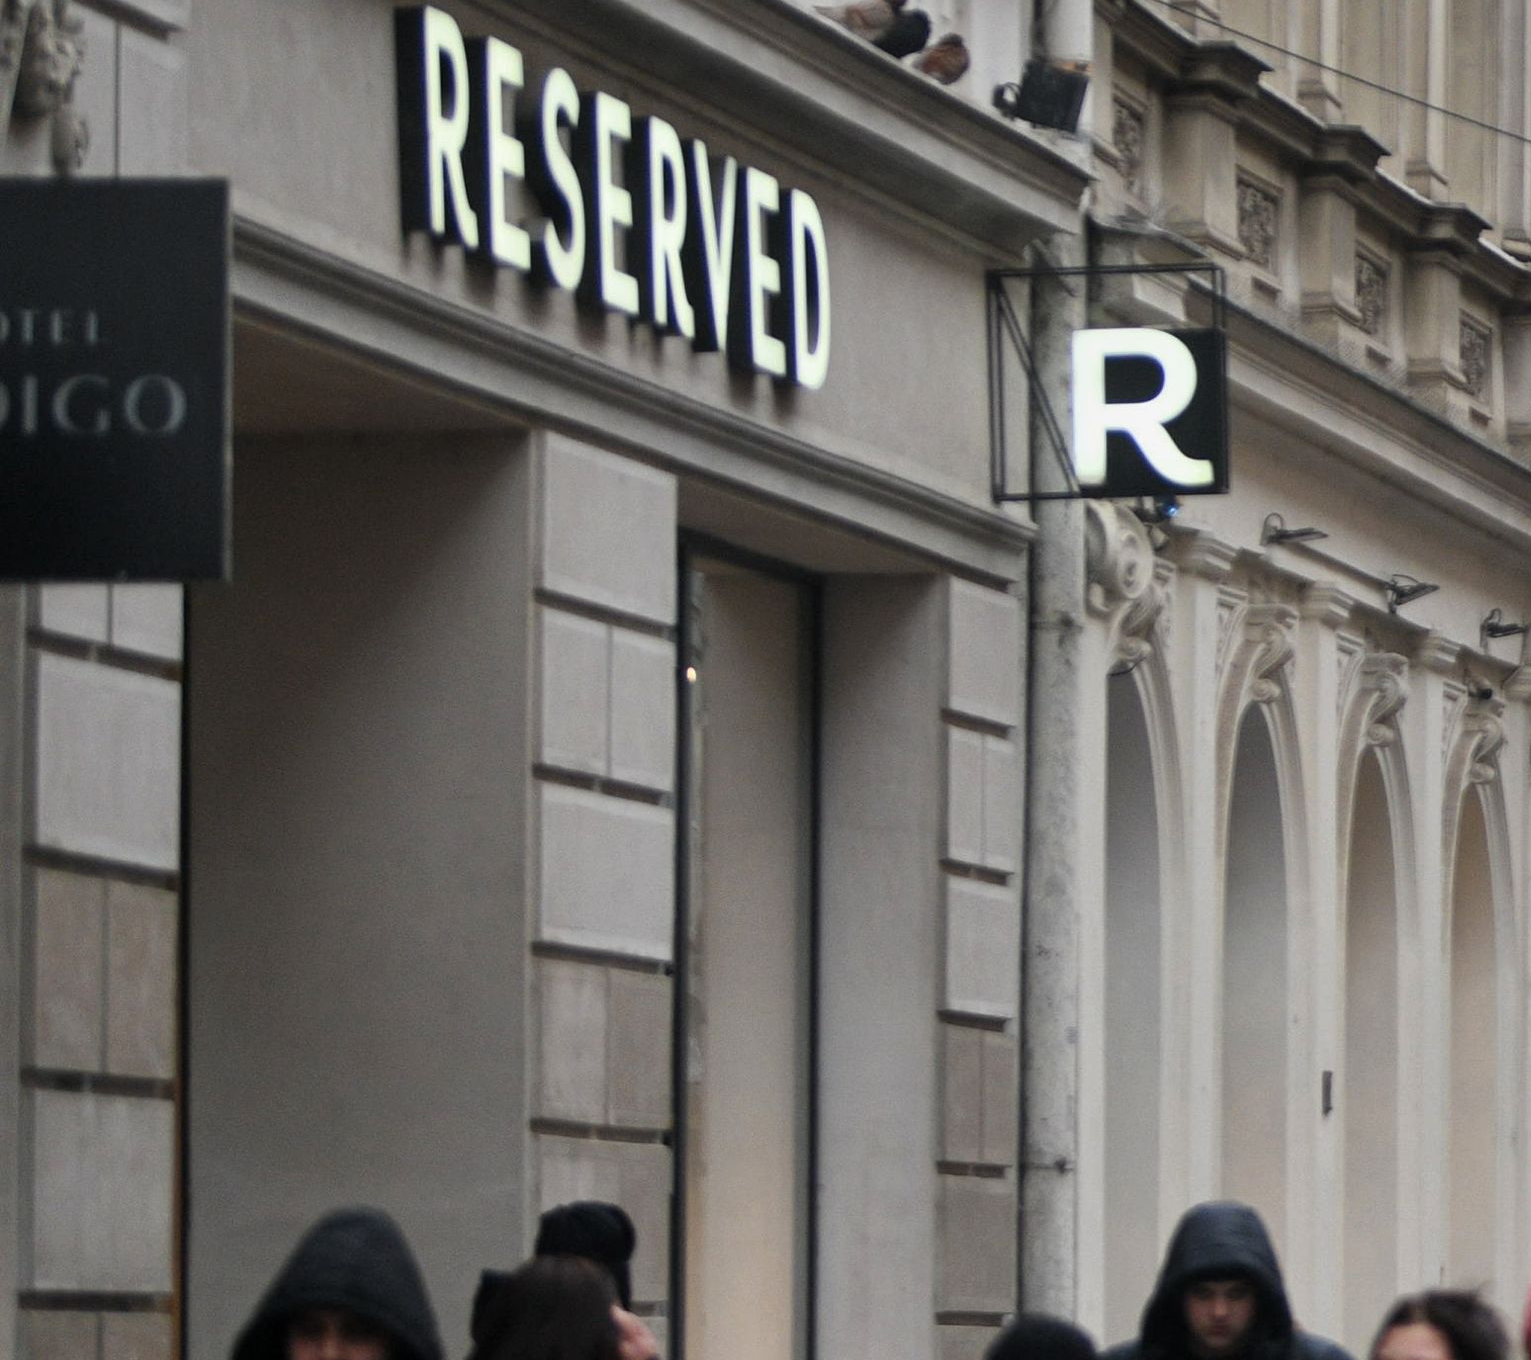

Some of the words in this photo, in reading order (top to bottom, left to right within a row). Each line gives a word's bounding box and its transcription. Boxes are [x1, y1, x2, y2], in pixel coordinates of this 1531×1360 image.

[396, 5, 831, 390] RESERVED
[0, 374, 187, 435] IGO
[1072, 328, 1215, 487] R
